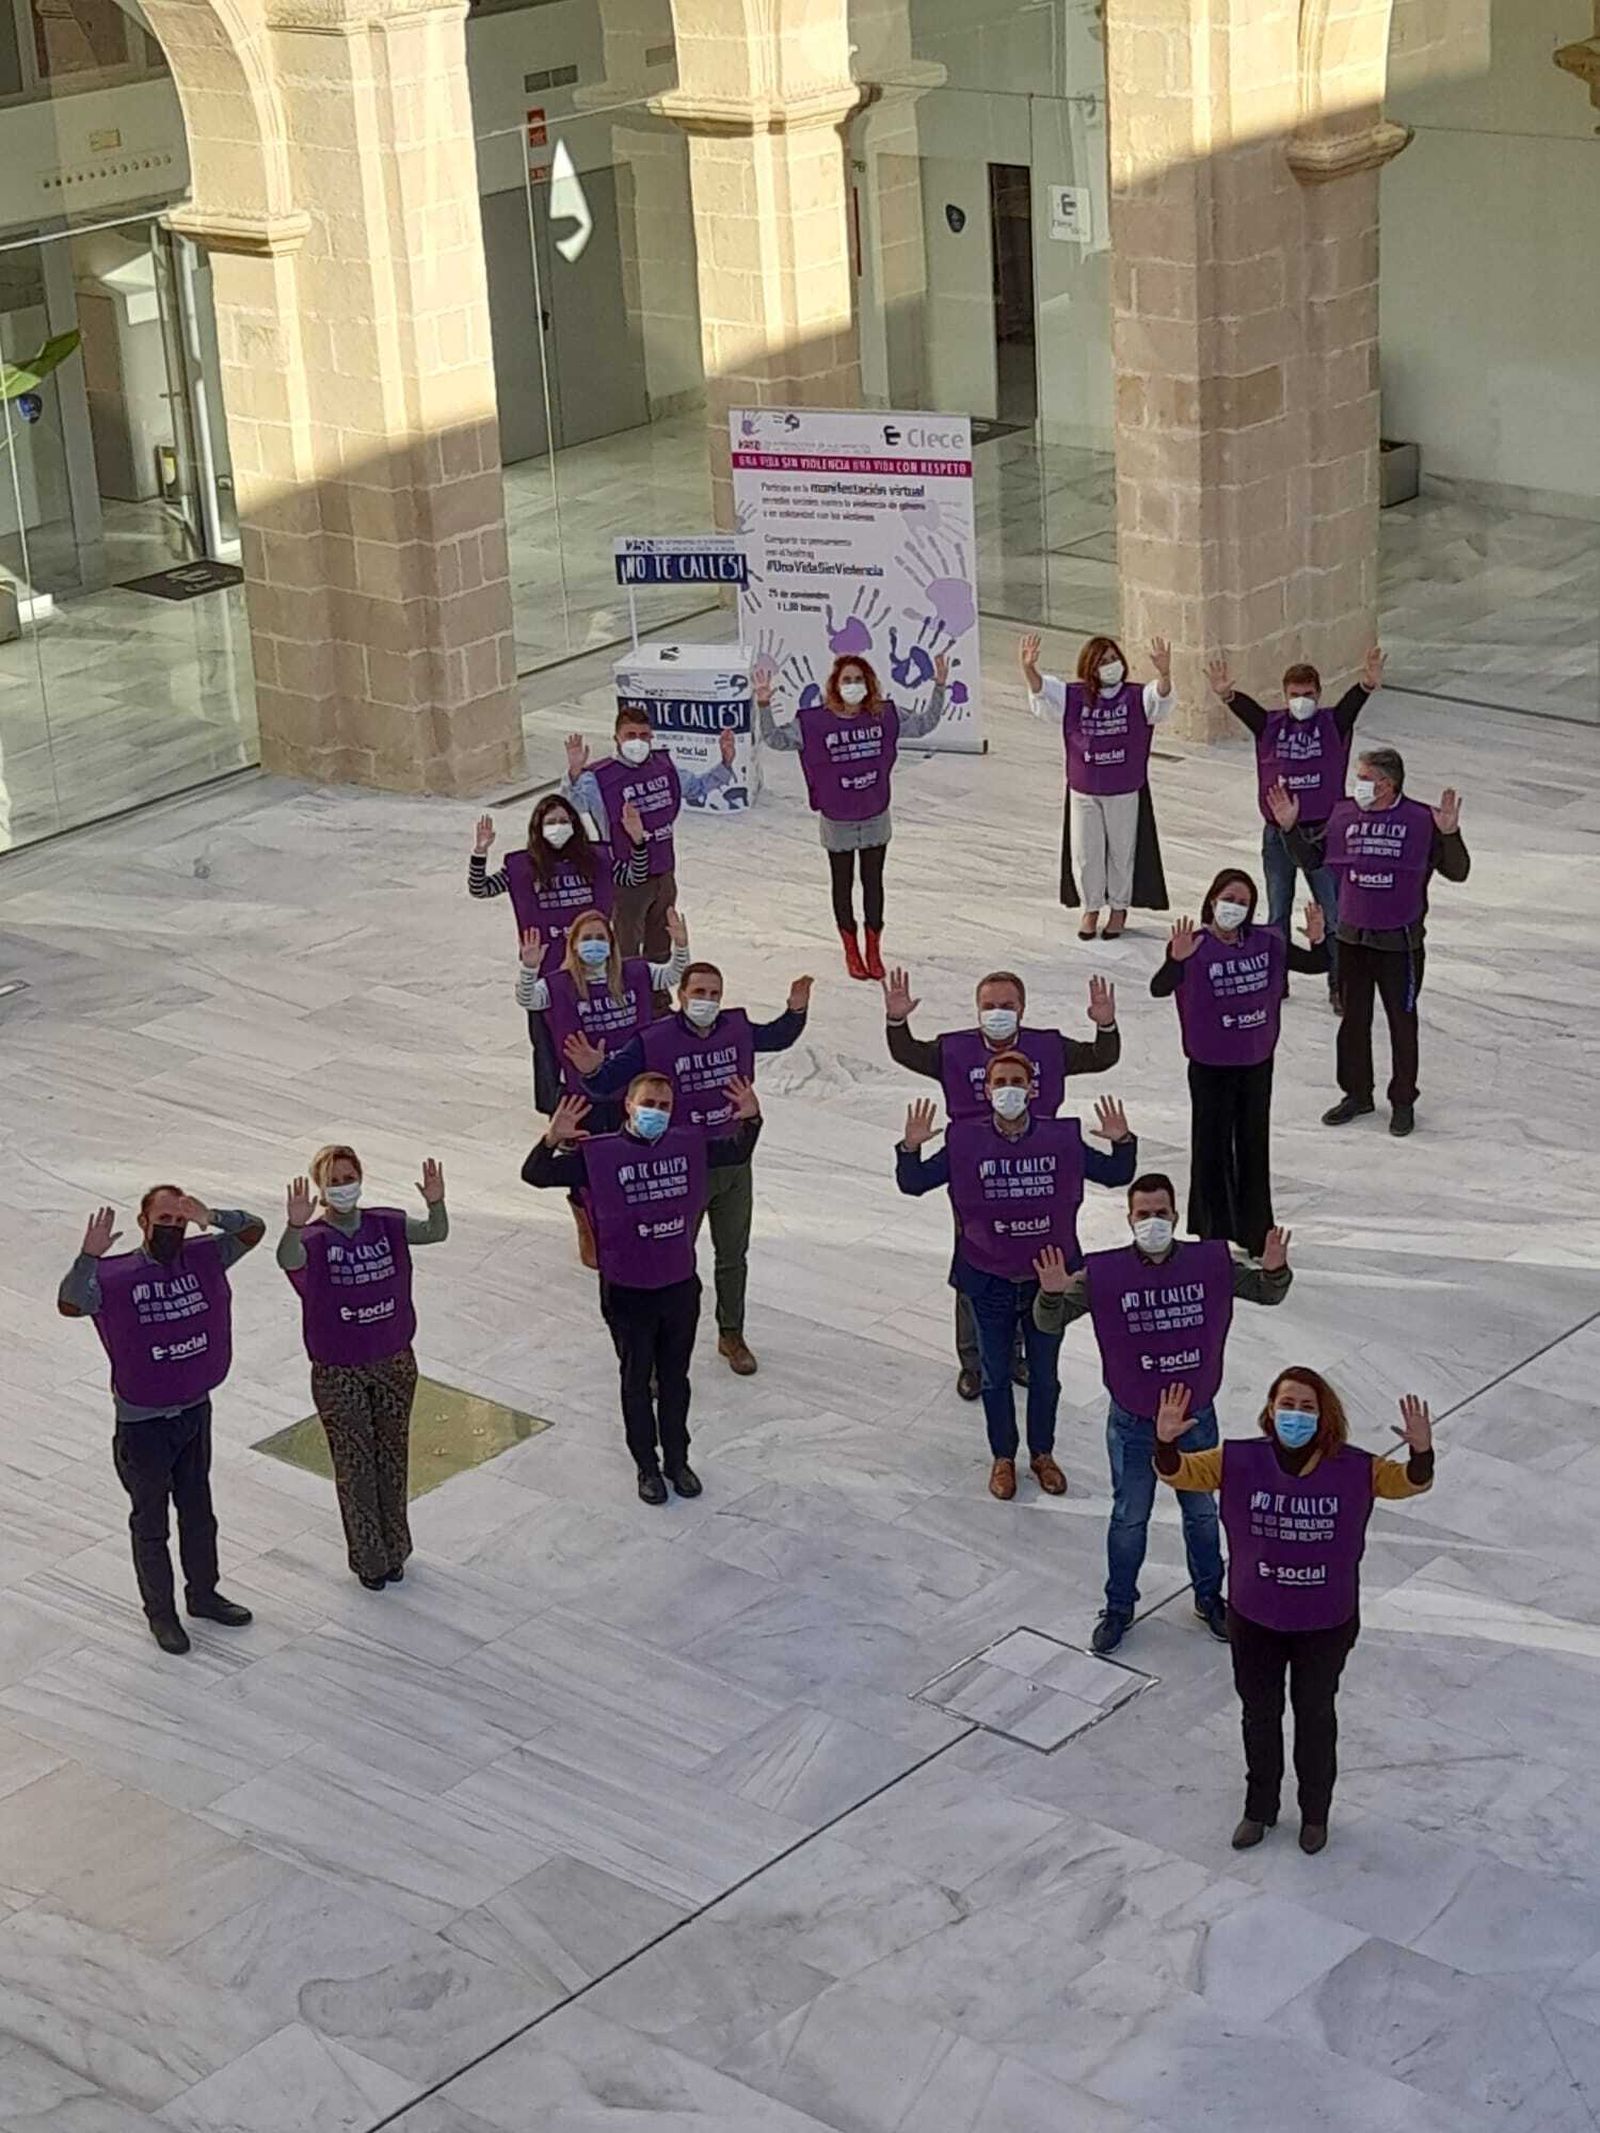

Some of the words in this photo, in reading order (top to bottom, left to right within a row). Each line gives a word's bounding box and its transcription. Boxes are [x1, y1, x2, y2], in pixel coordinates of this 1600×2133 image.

[907, 428, 965, 449] Clece
[800, 459, 850, 470] VIOLENCIA
[874, 462, 895, 472] VIDA
[896, 462, 918, 473] CON
[920, 463, 967, 475] RESPETO
[810, 482, 887, 495] manifestación
[889, 484, 925, 497] virtual
[654, 556, 672, 578] TE
[678, 555, 744, 579] CALLES!
[655, 701, 673, 726] TE
[680, 702, 745, 730] CALLES!
